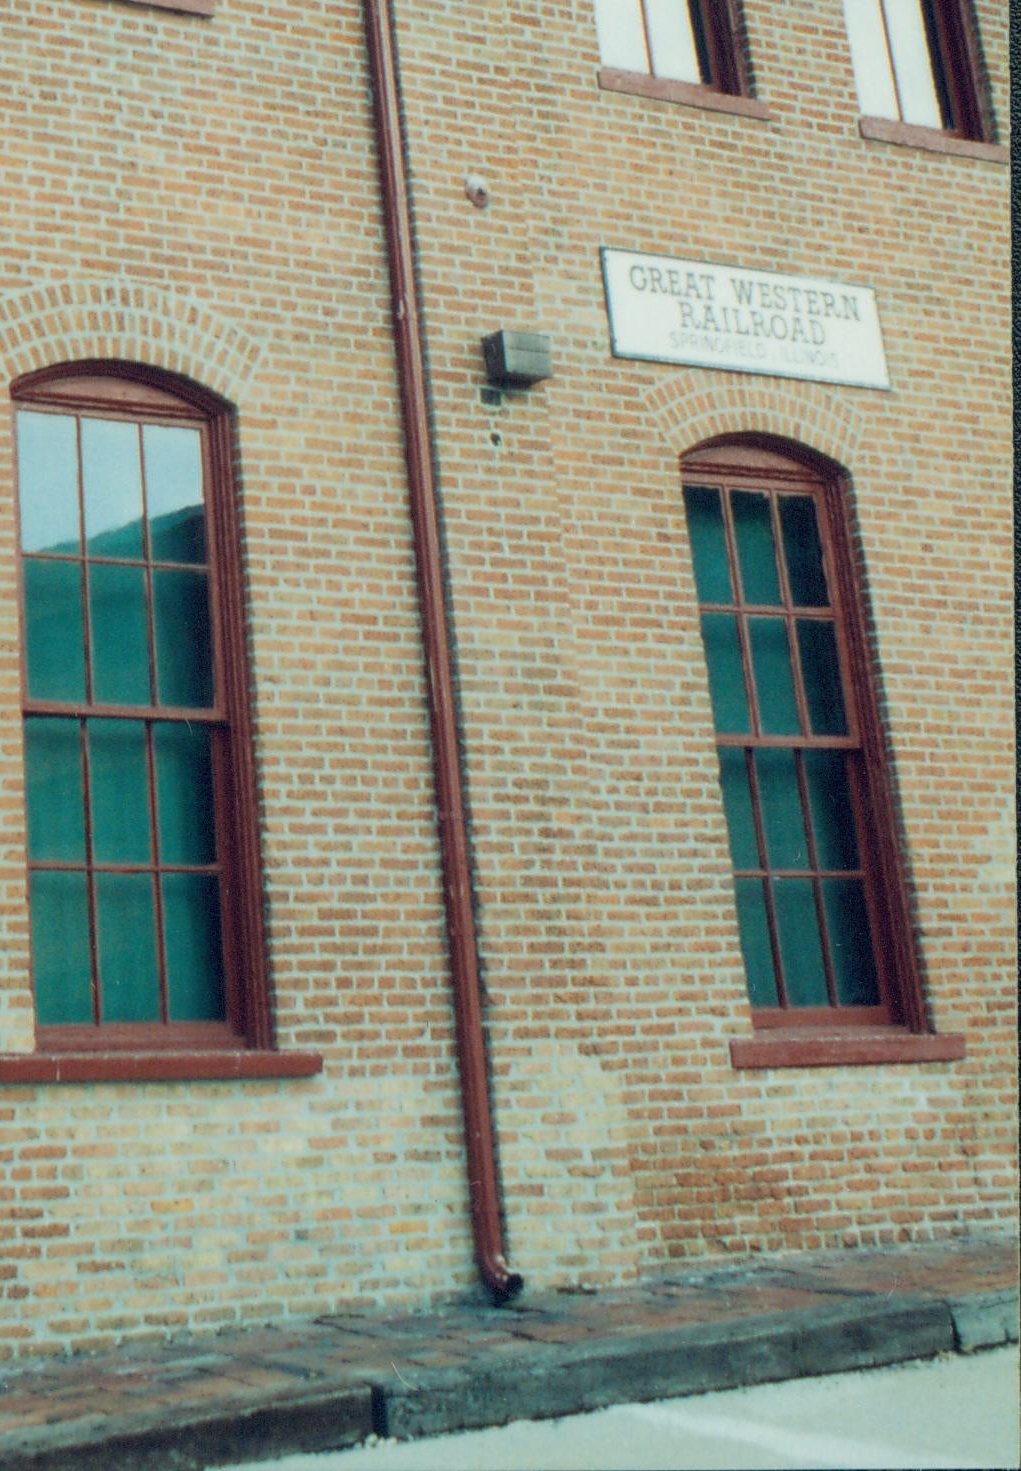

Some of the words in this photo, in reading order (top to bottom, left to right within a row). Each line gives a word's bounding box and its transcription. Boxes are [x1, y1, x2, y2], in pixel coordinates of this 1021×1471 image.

[629, 264, 715, 301] GREAT
[729, 277, 861, 322] WESTERN
[678, 299, 826, 345] RAILROAD
